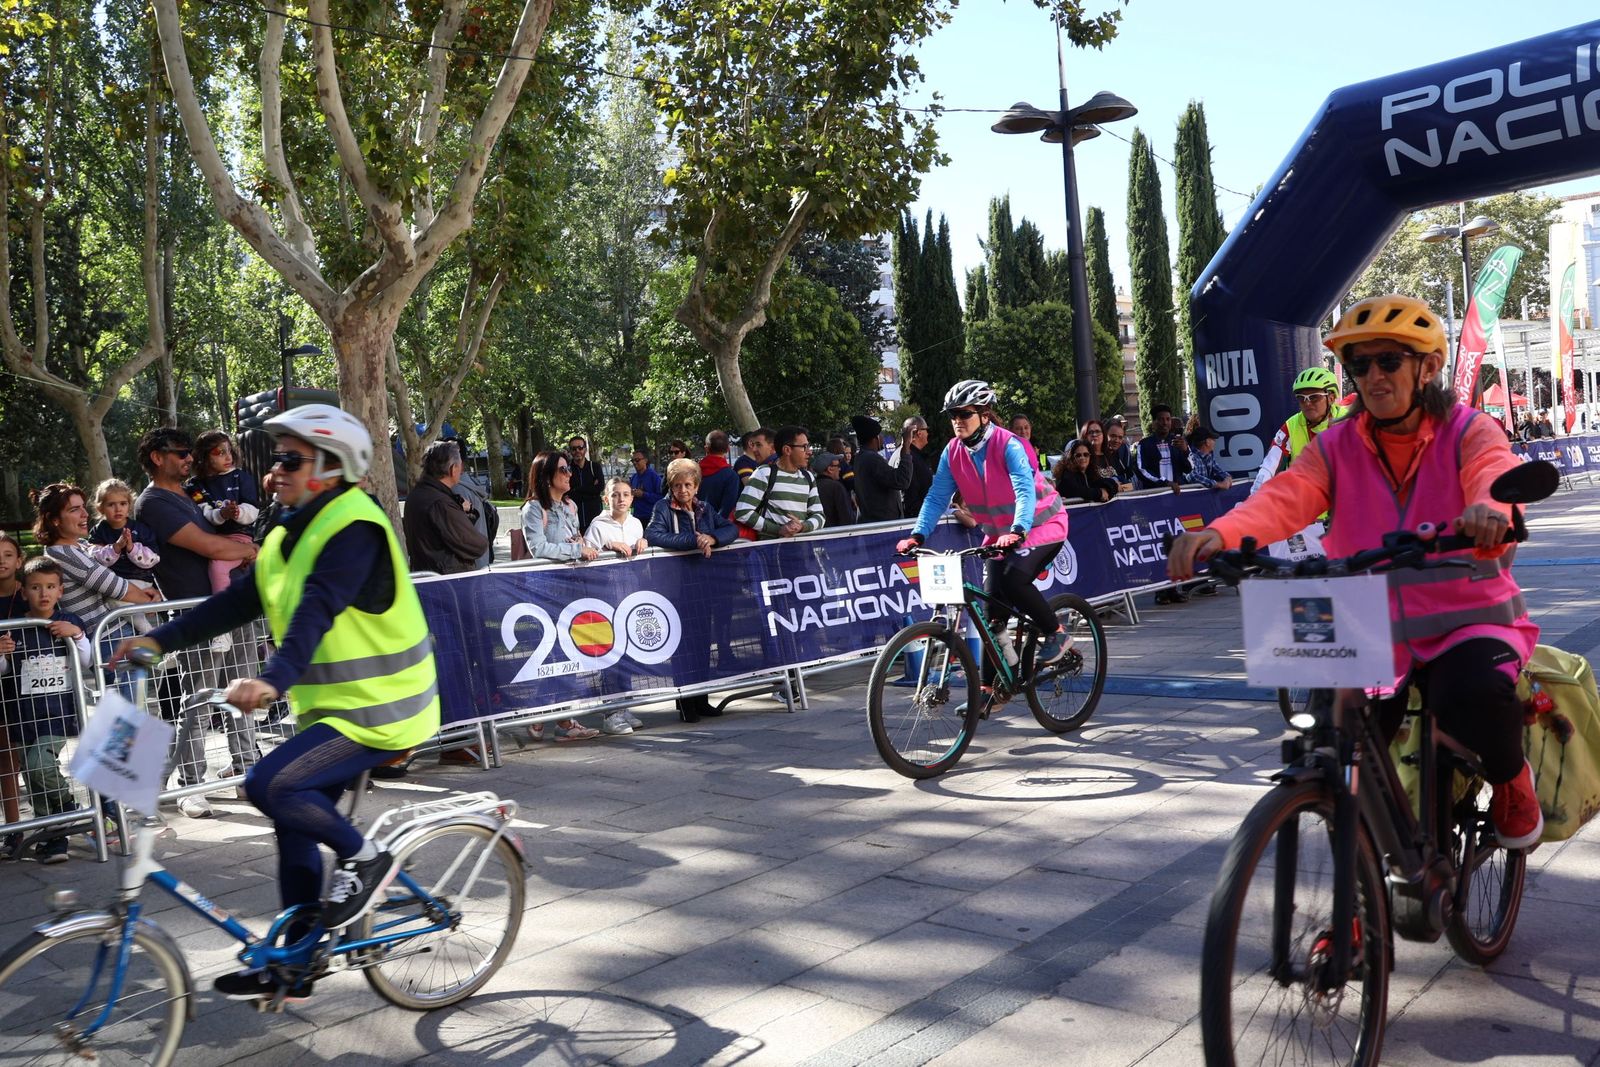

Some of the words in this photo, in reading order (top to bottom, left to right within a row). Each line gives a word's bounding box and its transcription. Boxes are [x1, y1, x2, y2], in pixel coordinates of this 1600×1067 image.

[1381, 42, 1600, 131] POLI
[1204, 348, 1259, 390] RUTA
[1106, 517, 1186, 546] POLICÍA
[761, 563, 910, 606] POLICÍA
[501, 590, 682, 684] 200
[1272, 645, 1358, 659] ORGANIZACIÓN
[31, 676, 65, 689] 2025
[537, 666, 554, 677] 1824
[562, 662, 580, 673] 2024
